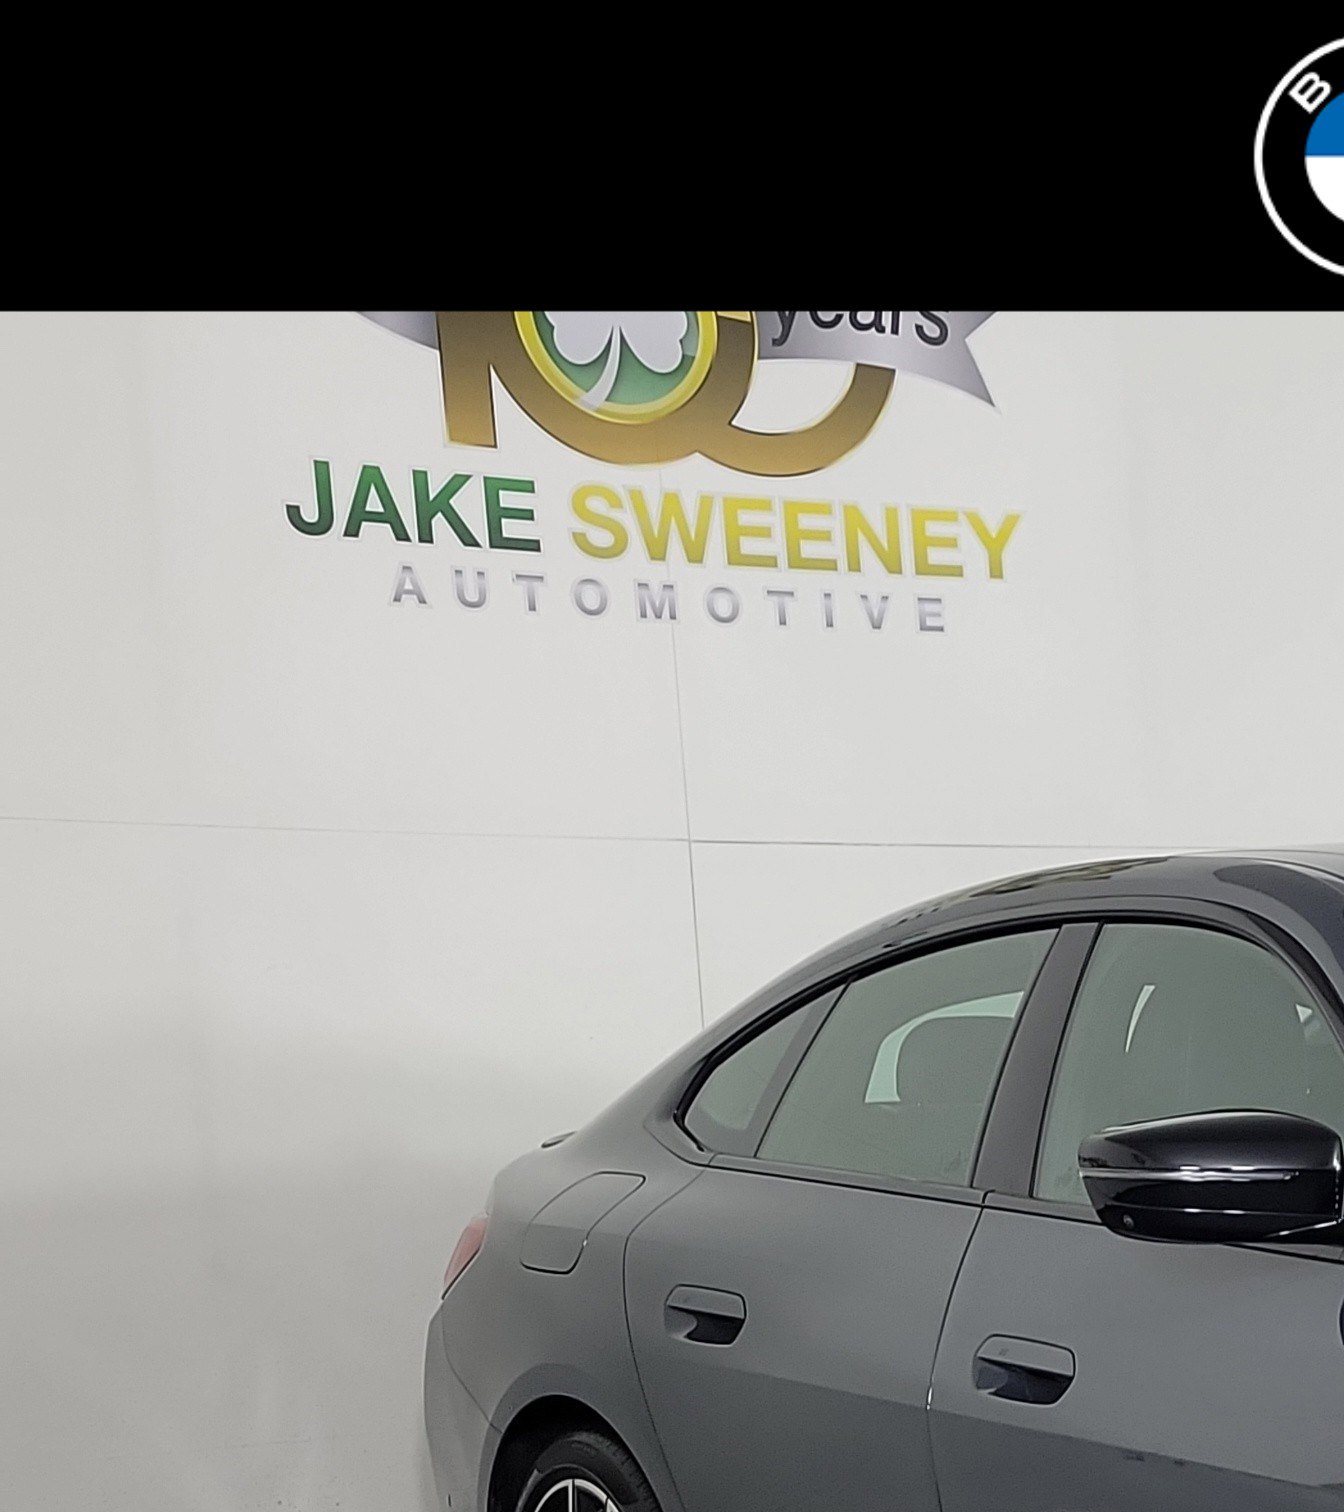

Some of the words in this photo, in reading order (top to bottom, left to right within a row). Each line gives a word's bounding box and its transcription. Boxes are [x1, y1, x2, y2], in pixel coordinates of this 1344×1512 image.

[285, 459, 542, 553] JAKE
[569, 483, 1021, 581] SWEENEY
[391, 564, 946, 633] AUTOMOTIVE
